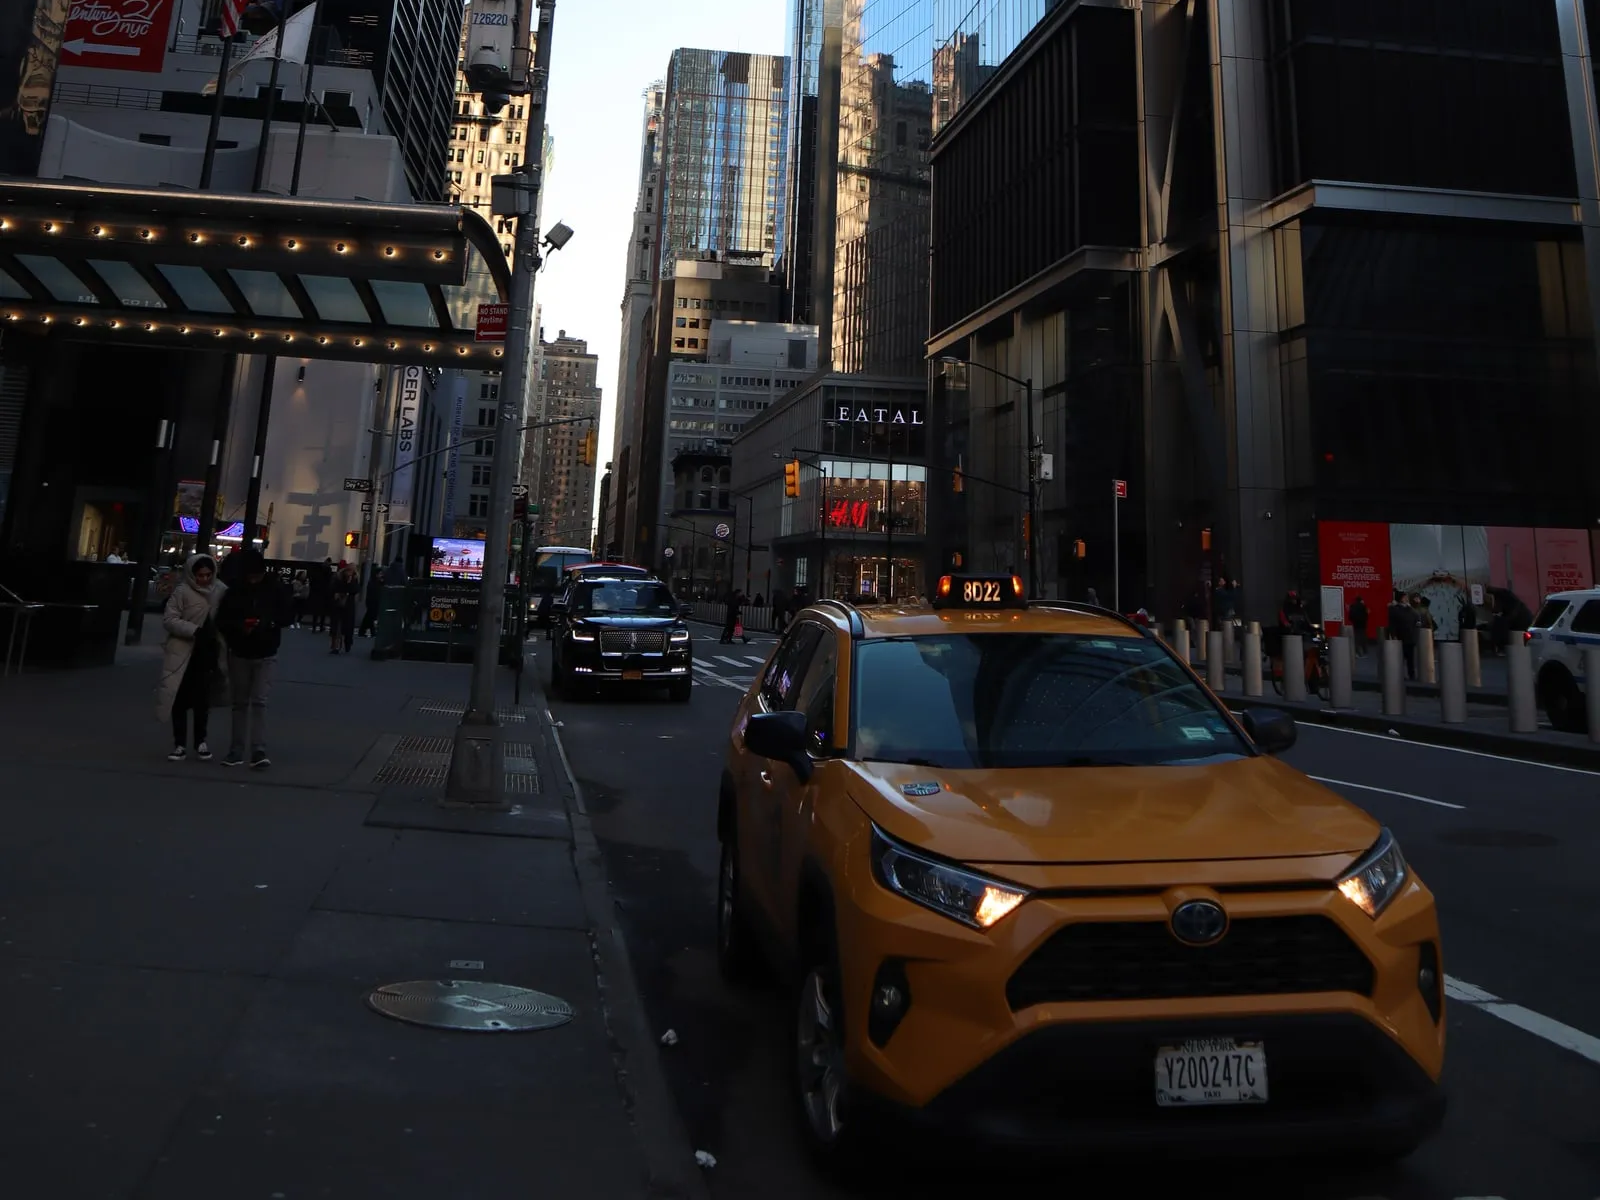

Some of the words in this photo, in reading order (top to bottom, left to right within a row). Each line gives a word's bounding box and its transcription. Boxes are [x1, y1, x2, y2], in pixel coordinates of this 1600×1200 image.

[473, 13, 508, 26] 726220
[119, 21, 149, 38] nyc
[480, 307, 488, 315] NO
[480, 316, 503, 325] Anytime
[838, 406, 924, 425] EATAL
[399, 407, 416, 452] LABS
[1336, 565, 1376, 573] DISCOVER
[1331, 572, 1381, 581] SOMEWHERE
[1343, 580, 1371, 588] ICONIC
[963, 580, 1001, 603] 8D22
[430, 601, 452, 609] Station
[1164, 1054, 1256, 1089] Y200247C
[1203, 1090, 1221, 1098] TAXI
